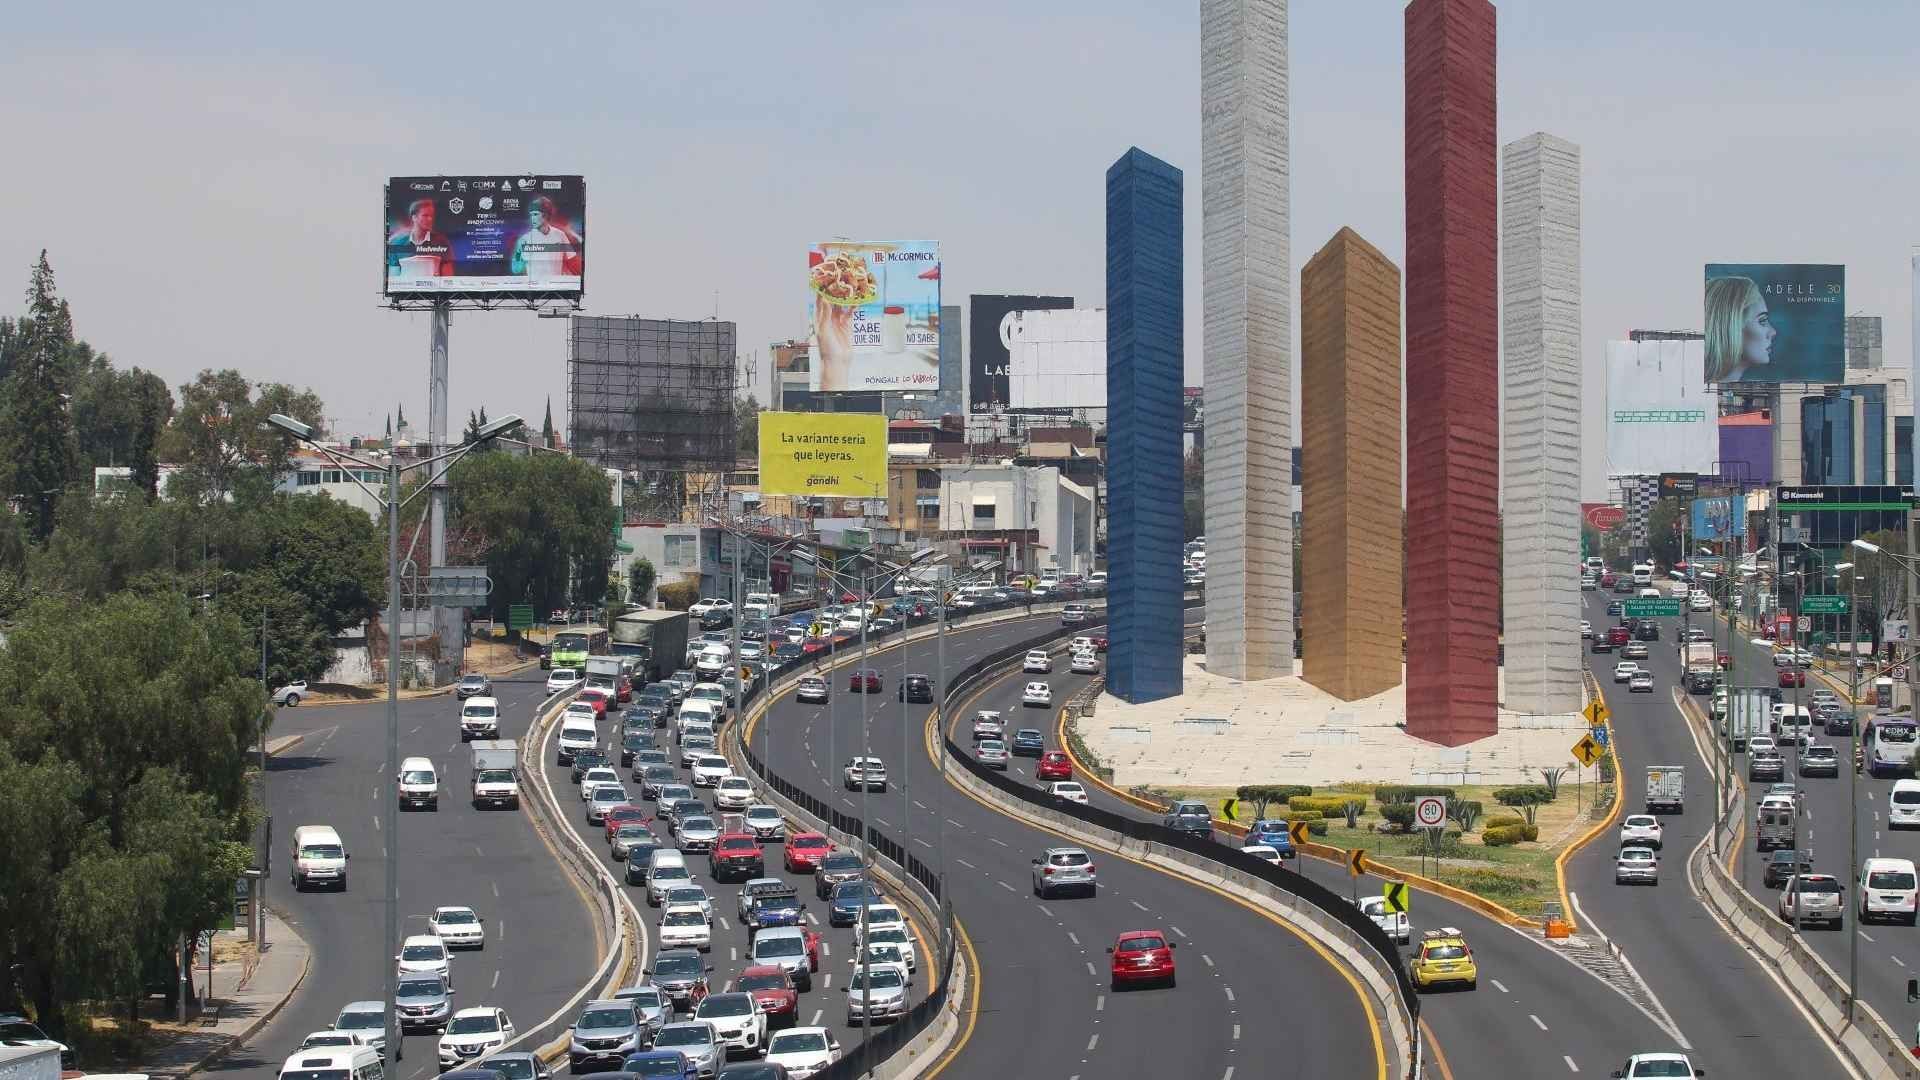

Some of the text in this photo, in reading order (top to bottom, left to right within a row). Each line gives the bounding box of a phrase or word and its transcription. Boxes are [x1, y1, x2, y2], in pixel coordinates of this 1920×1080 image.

[1765, 283, 1841, 295] ADELE 30
[853, 310, 865, 321] SE
[853, 322, 881, 334] SABE
[854, 333, 936, 345] QUE SIN NO SABE
[781, 432, 794, 443] La
[797, 432, 839, 445] variante
[793, 449, 855, 463] que leyeras.
[806, 476, 839, 486] gandhi
[1791, 491, 1823, 499] Kawasaki
[1424, 804, 1437, 815] 80
